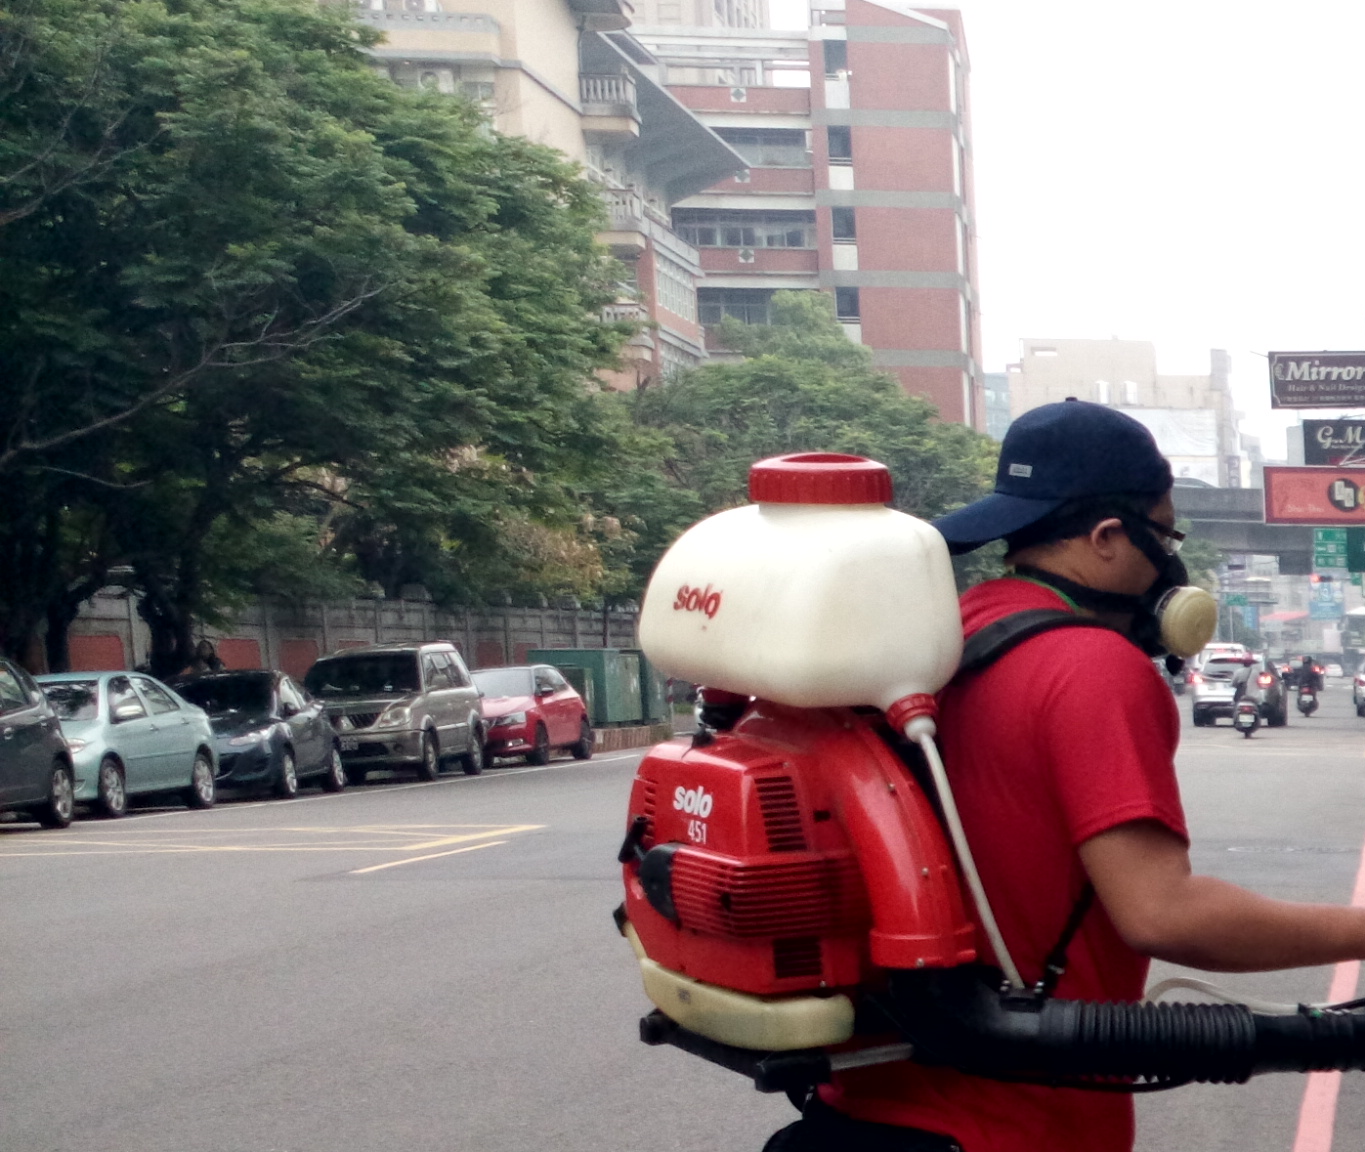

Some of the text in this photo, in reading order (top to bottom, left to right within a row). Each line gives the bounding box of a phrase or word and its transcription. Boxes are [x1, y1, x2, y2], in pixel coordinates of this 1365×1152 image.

[1288, 384, 1307, 392] Hair
[673, 785, 713, 818] solo
[687, 819, 707, 845] 451
